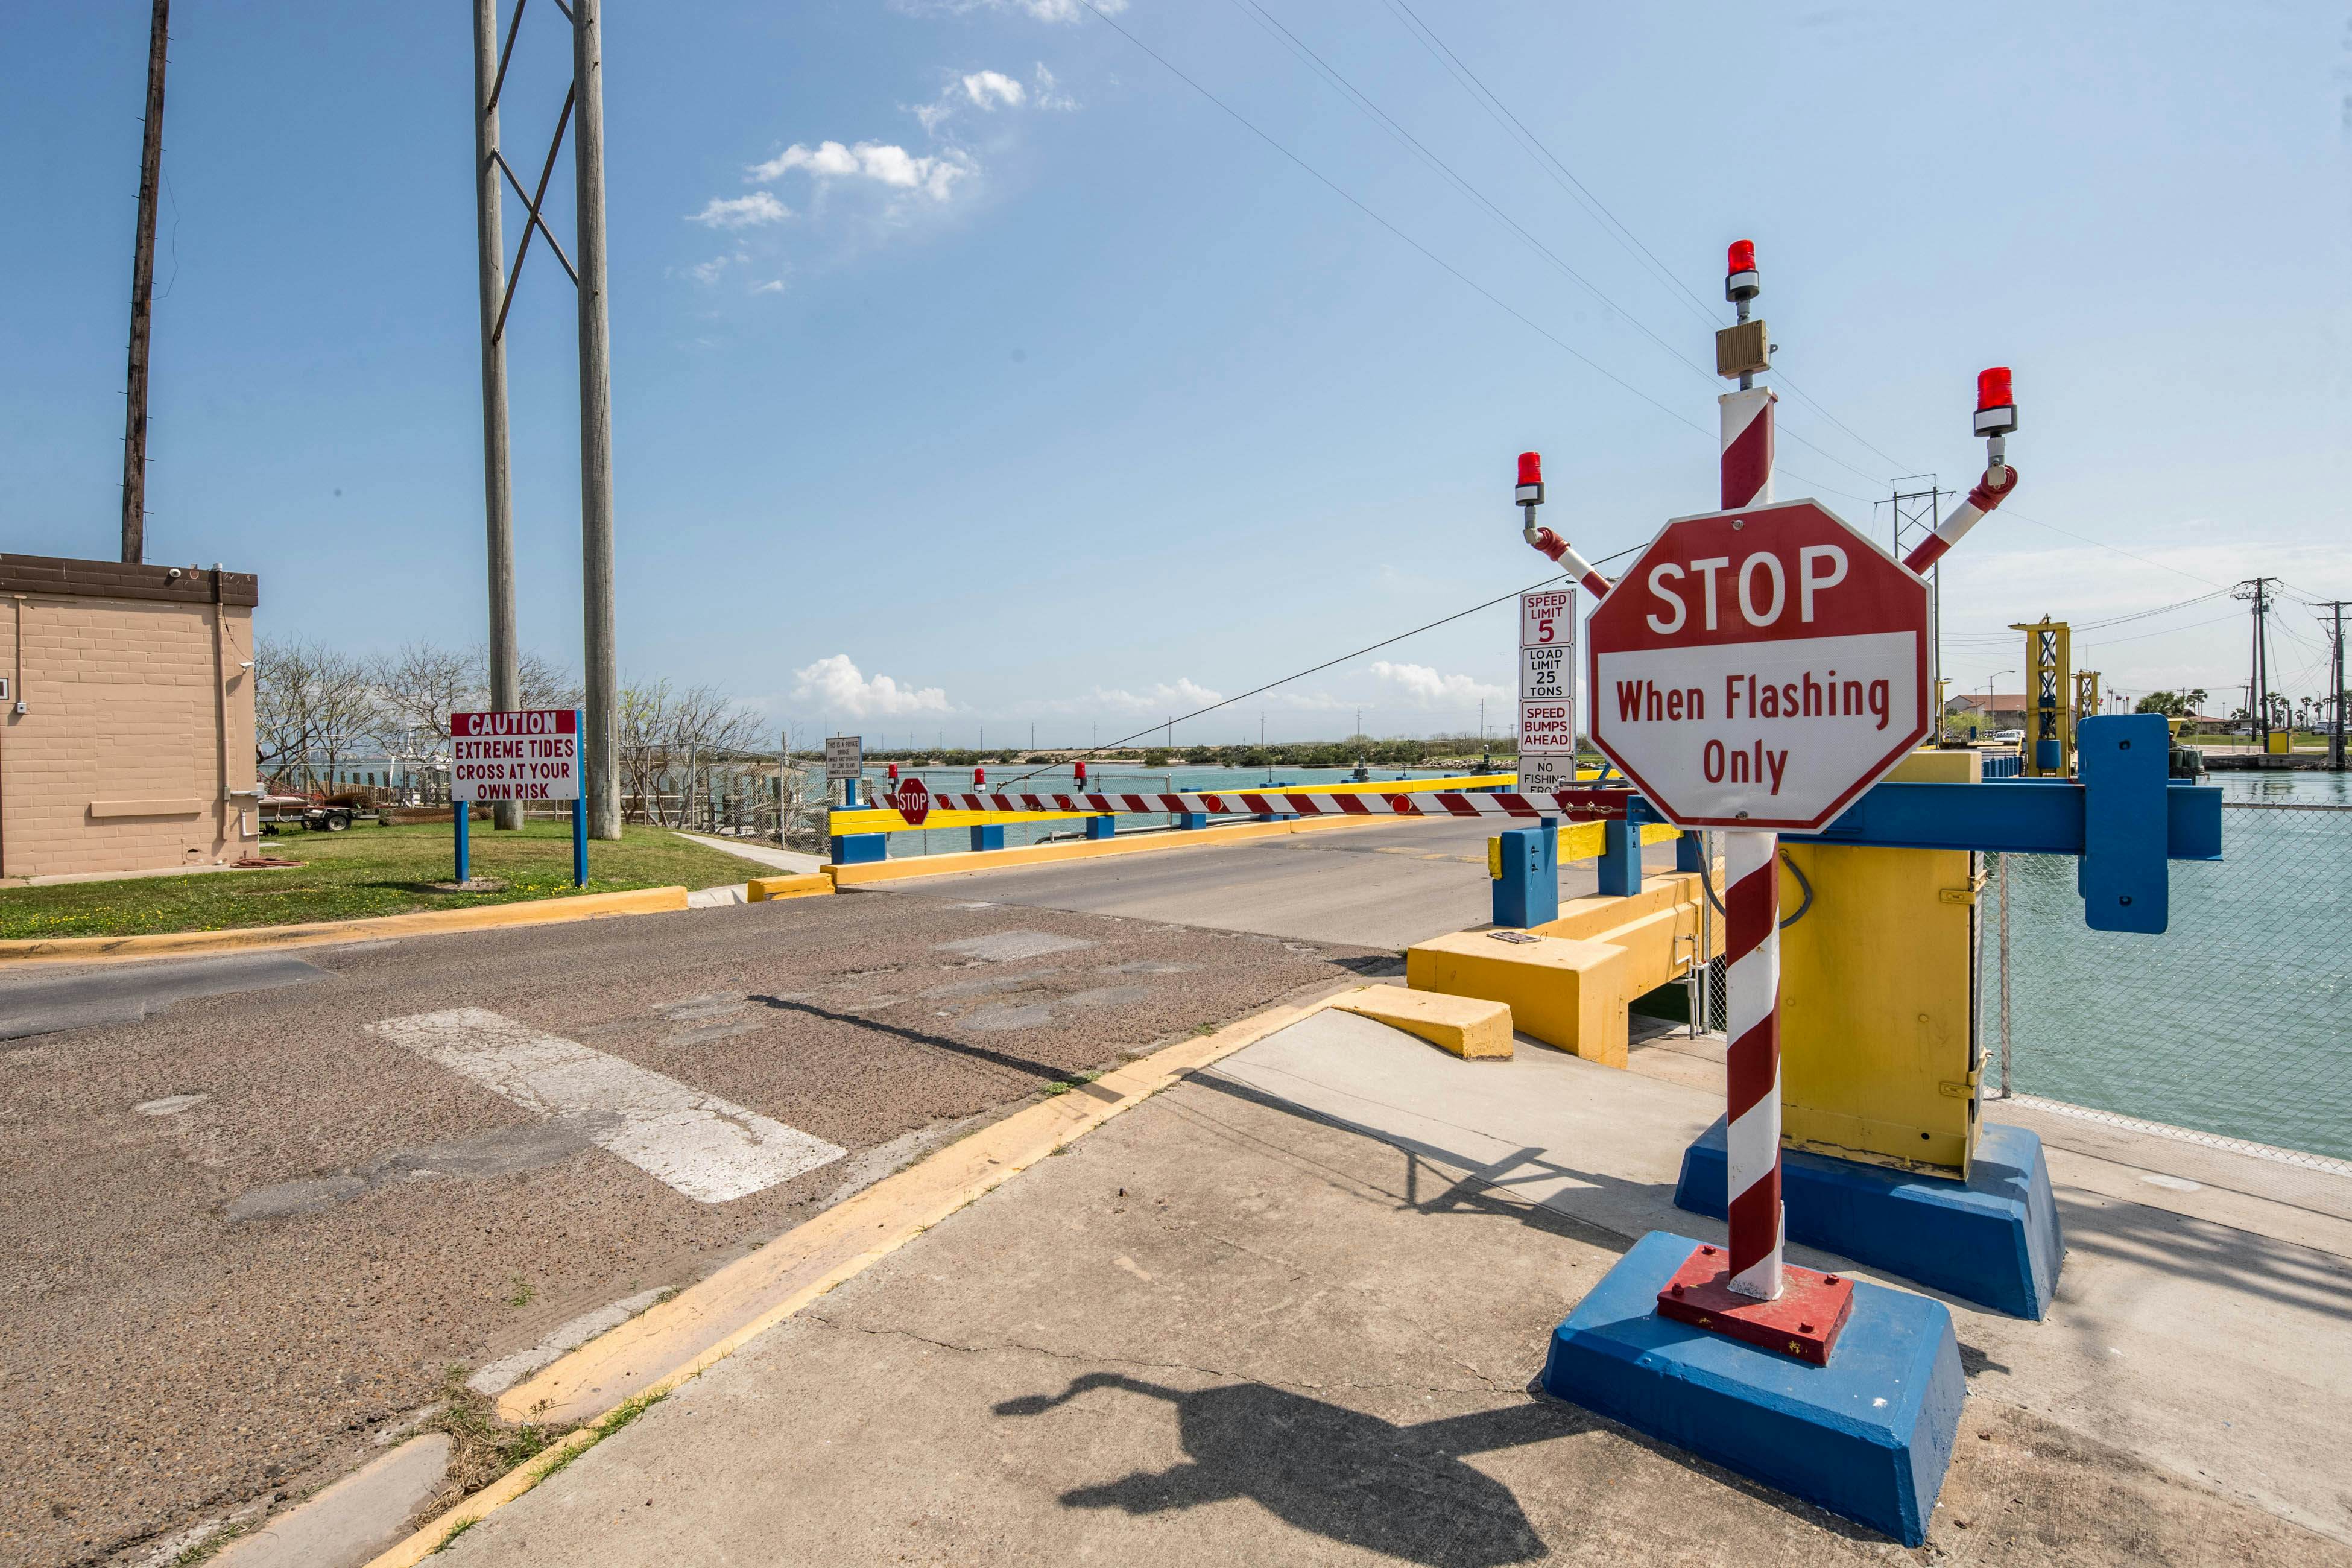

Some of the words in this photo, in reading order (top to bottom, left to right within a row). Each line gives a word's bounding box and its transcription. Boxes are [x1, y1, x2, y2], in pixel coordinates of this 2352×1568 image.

[1646, 544, 1849, 635] STOP
[1528, 595, 1567, 608] SPEED
[1531, 607, 1563, 619] LIMIT
[1538, 619, 1554, 643] 5
[1530, 649, 1563, 659] LOAD
[1532, 660, 1561, 670] LIMIT
[1536, 671, 1555, 684] 25
[1530, 686, 1563, 696] TONS
[1616, 679, 1704, 722] When
[1726, 669, 1889, 731] Flashing
[1527, 707, 1565, 718] SPEED
[468, 712, 557, 735] CAUTION
[1525, 721, 1567, 732] BUMPS
[1524, 735, 1568, 745] AHEAD
[455, 740, 524, 760] EXTREME
[529, 739, 574, 758] TIDES
[457, 763, 505, 780] CROSS
[509, 763, 526, 779] AT
[529, 762, 570, 779] YOUR
[1538, 762, 1553, 772] NO
[1703, 739, 1788, 796] Only
[478, 783, 511, 800] OWN
[516, 783, 549, 799] RISK
[900, 792, 927, 811] STOP
